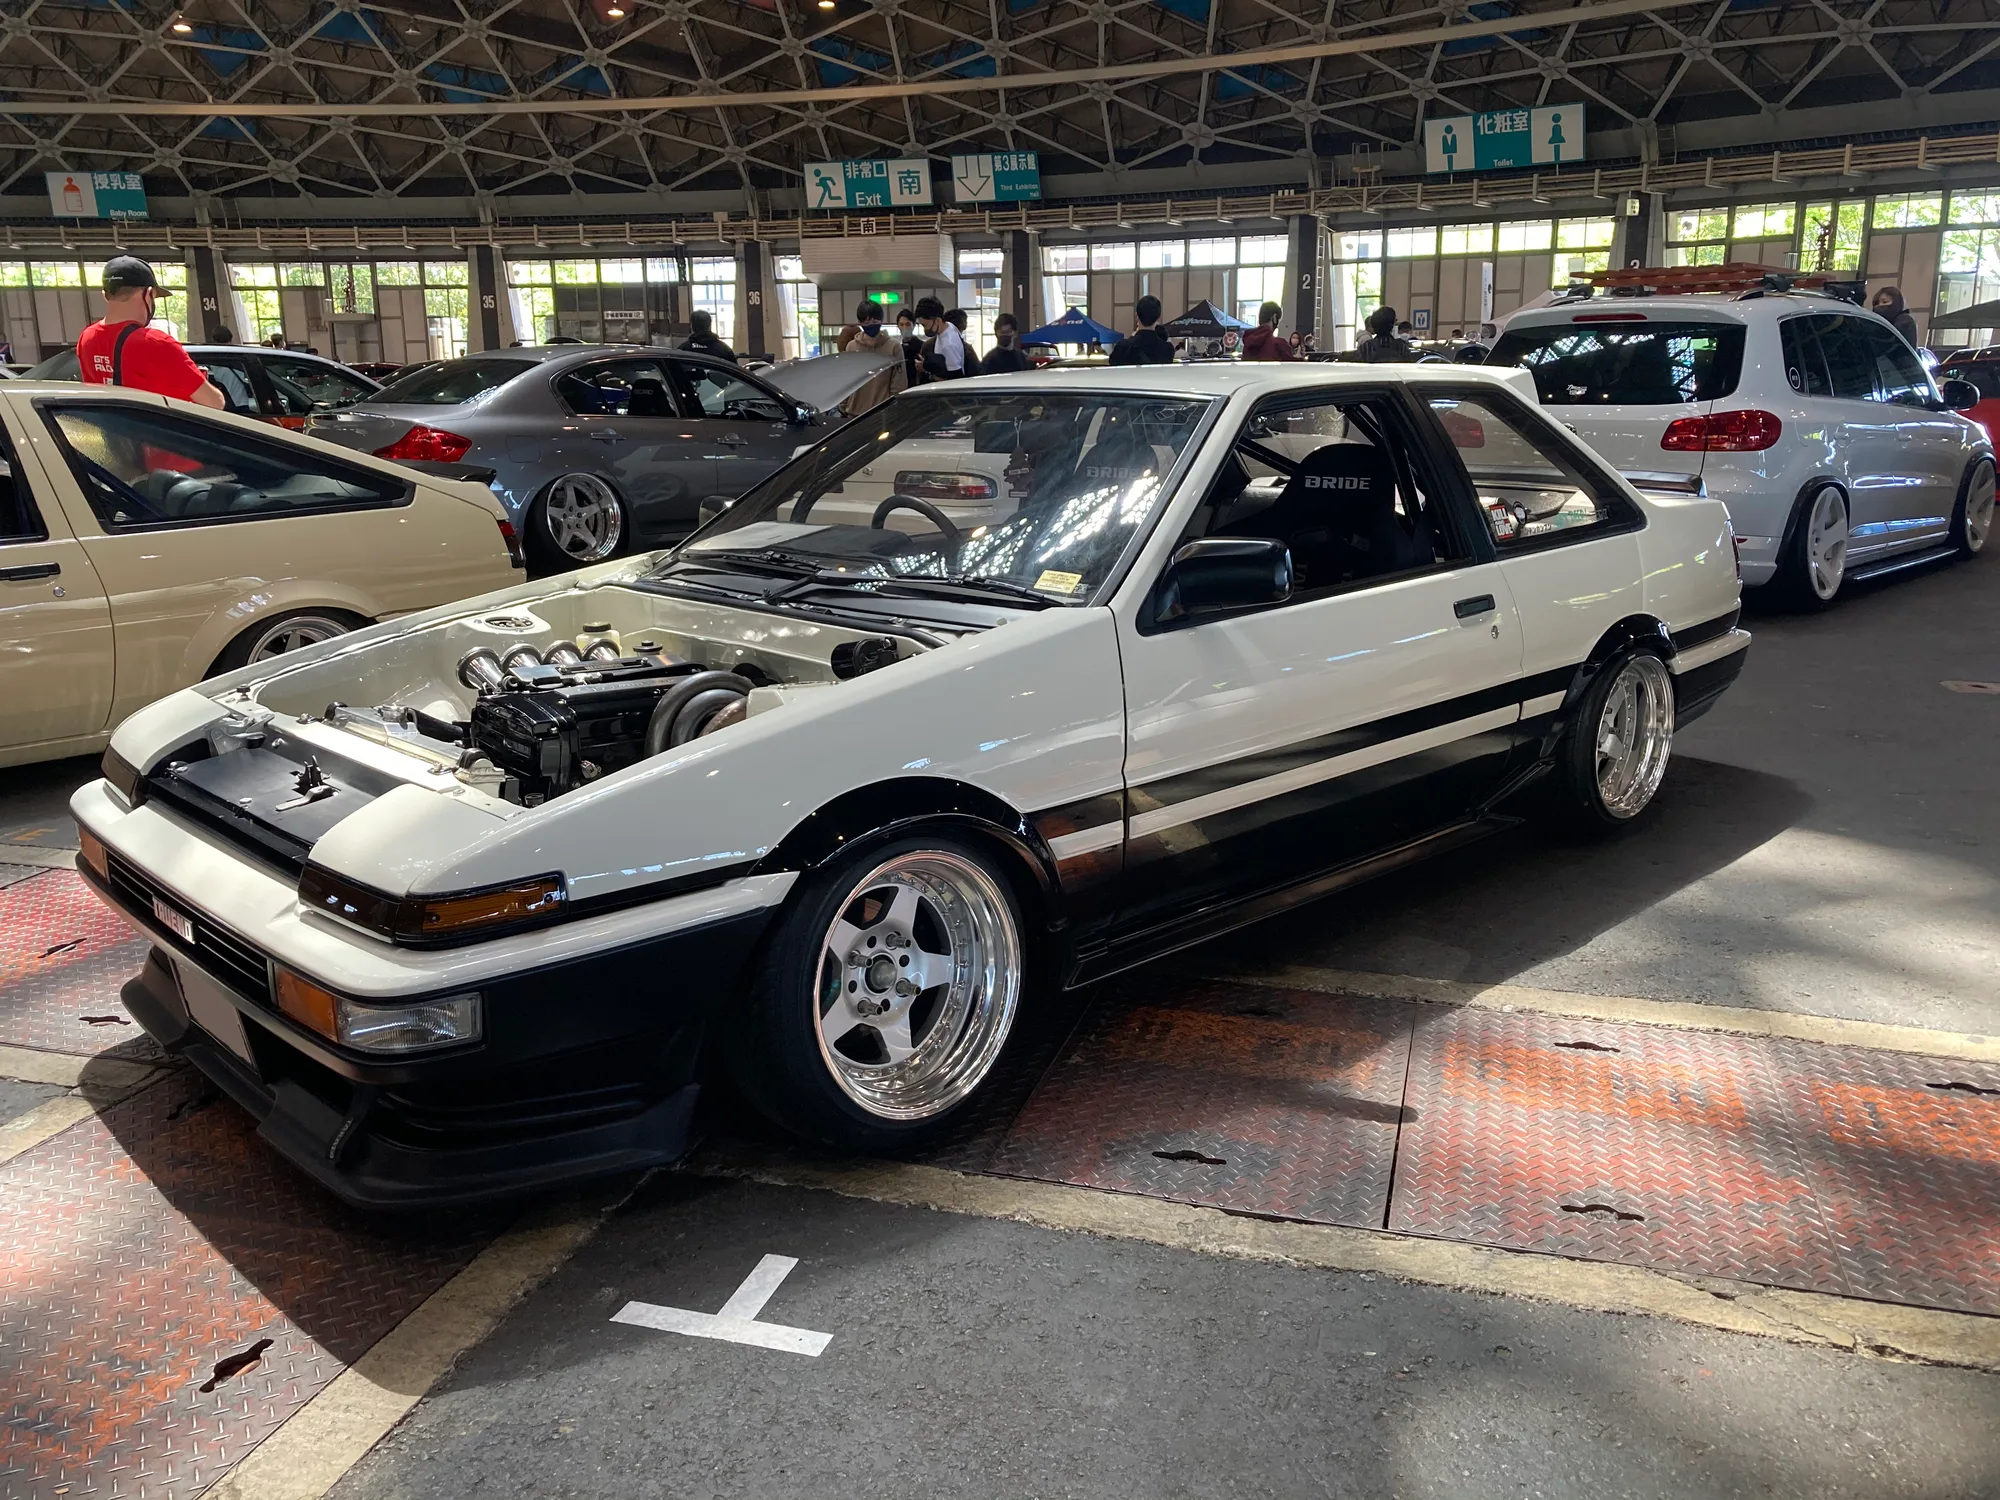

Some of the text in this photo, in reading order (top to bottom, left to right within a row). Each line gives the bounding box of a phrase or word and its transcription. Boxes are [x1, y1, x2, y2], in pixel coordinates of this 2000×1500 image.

[1477, 111, 1529, 135] 化粧室
[845, 161, 887, 179] 非常口
[1493, 159, 1513, 167] Toilet
[93, 173, 142, 190] 授乳室
[897, 169, 921, 195] 南
[855, 192, 882, 206] Exit
[109, 210, 126, 218] Baby
[861, 218, 874, 233] 南
[1302, 274, 1311, 289] 2
[748, 291, 760, 305] 36
[1018, 284, 1024, 299] 1
[203, 297, 217, 311] 34
[482, 295, 495, 308] 35
[1304, 475, 1371, 490] BRIDE
[1491, 507, 1509, 521] KILL
[1495, 523, 1513, 536] LOVE
